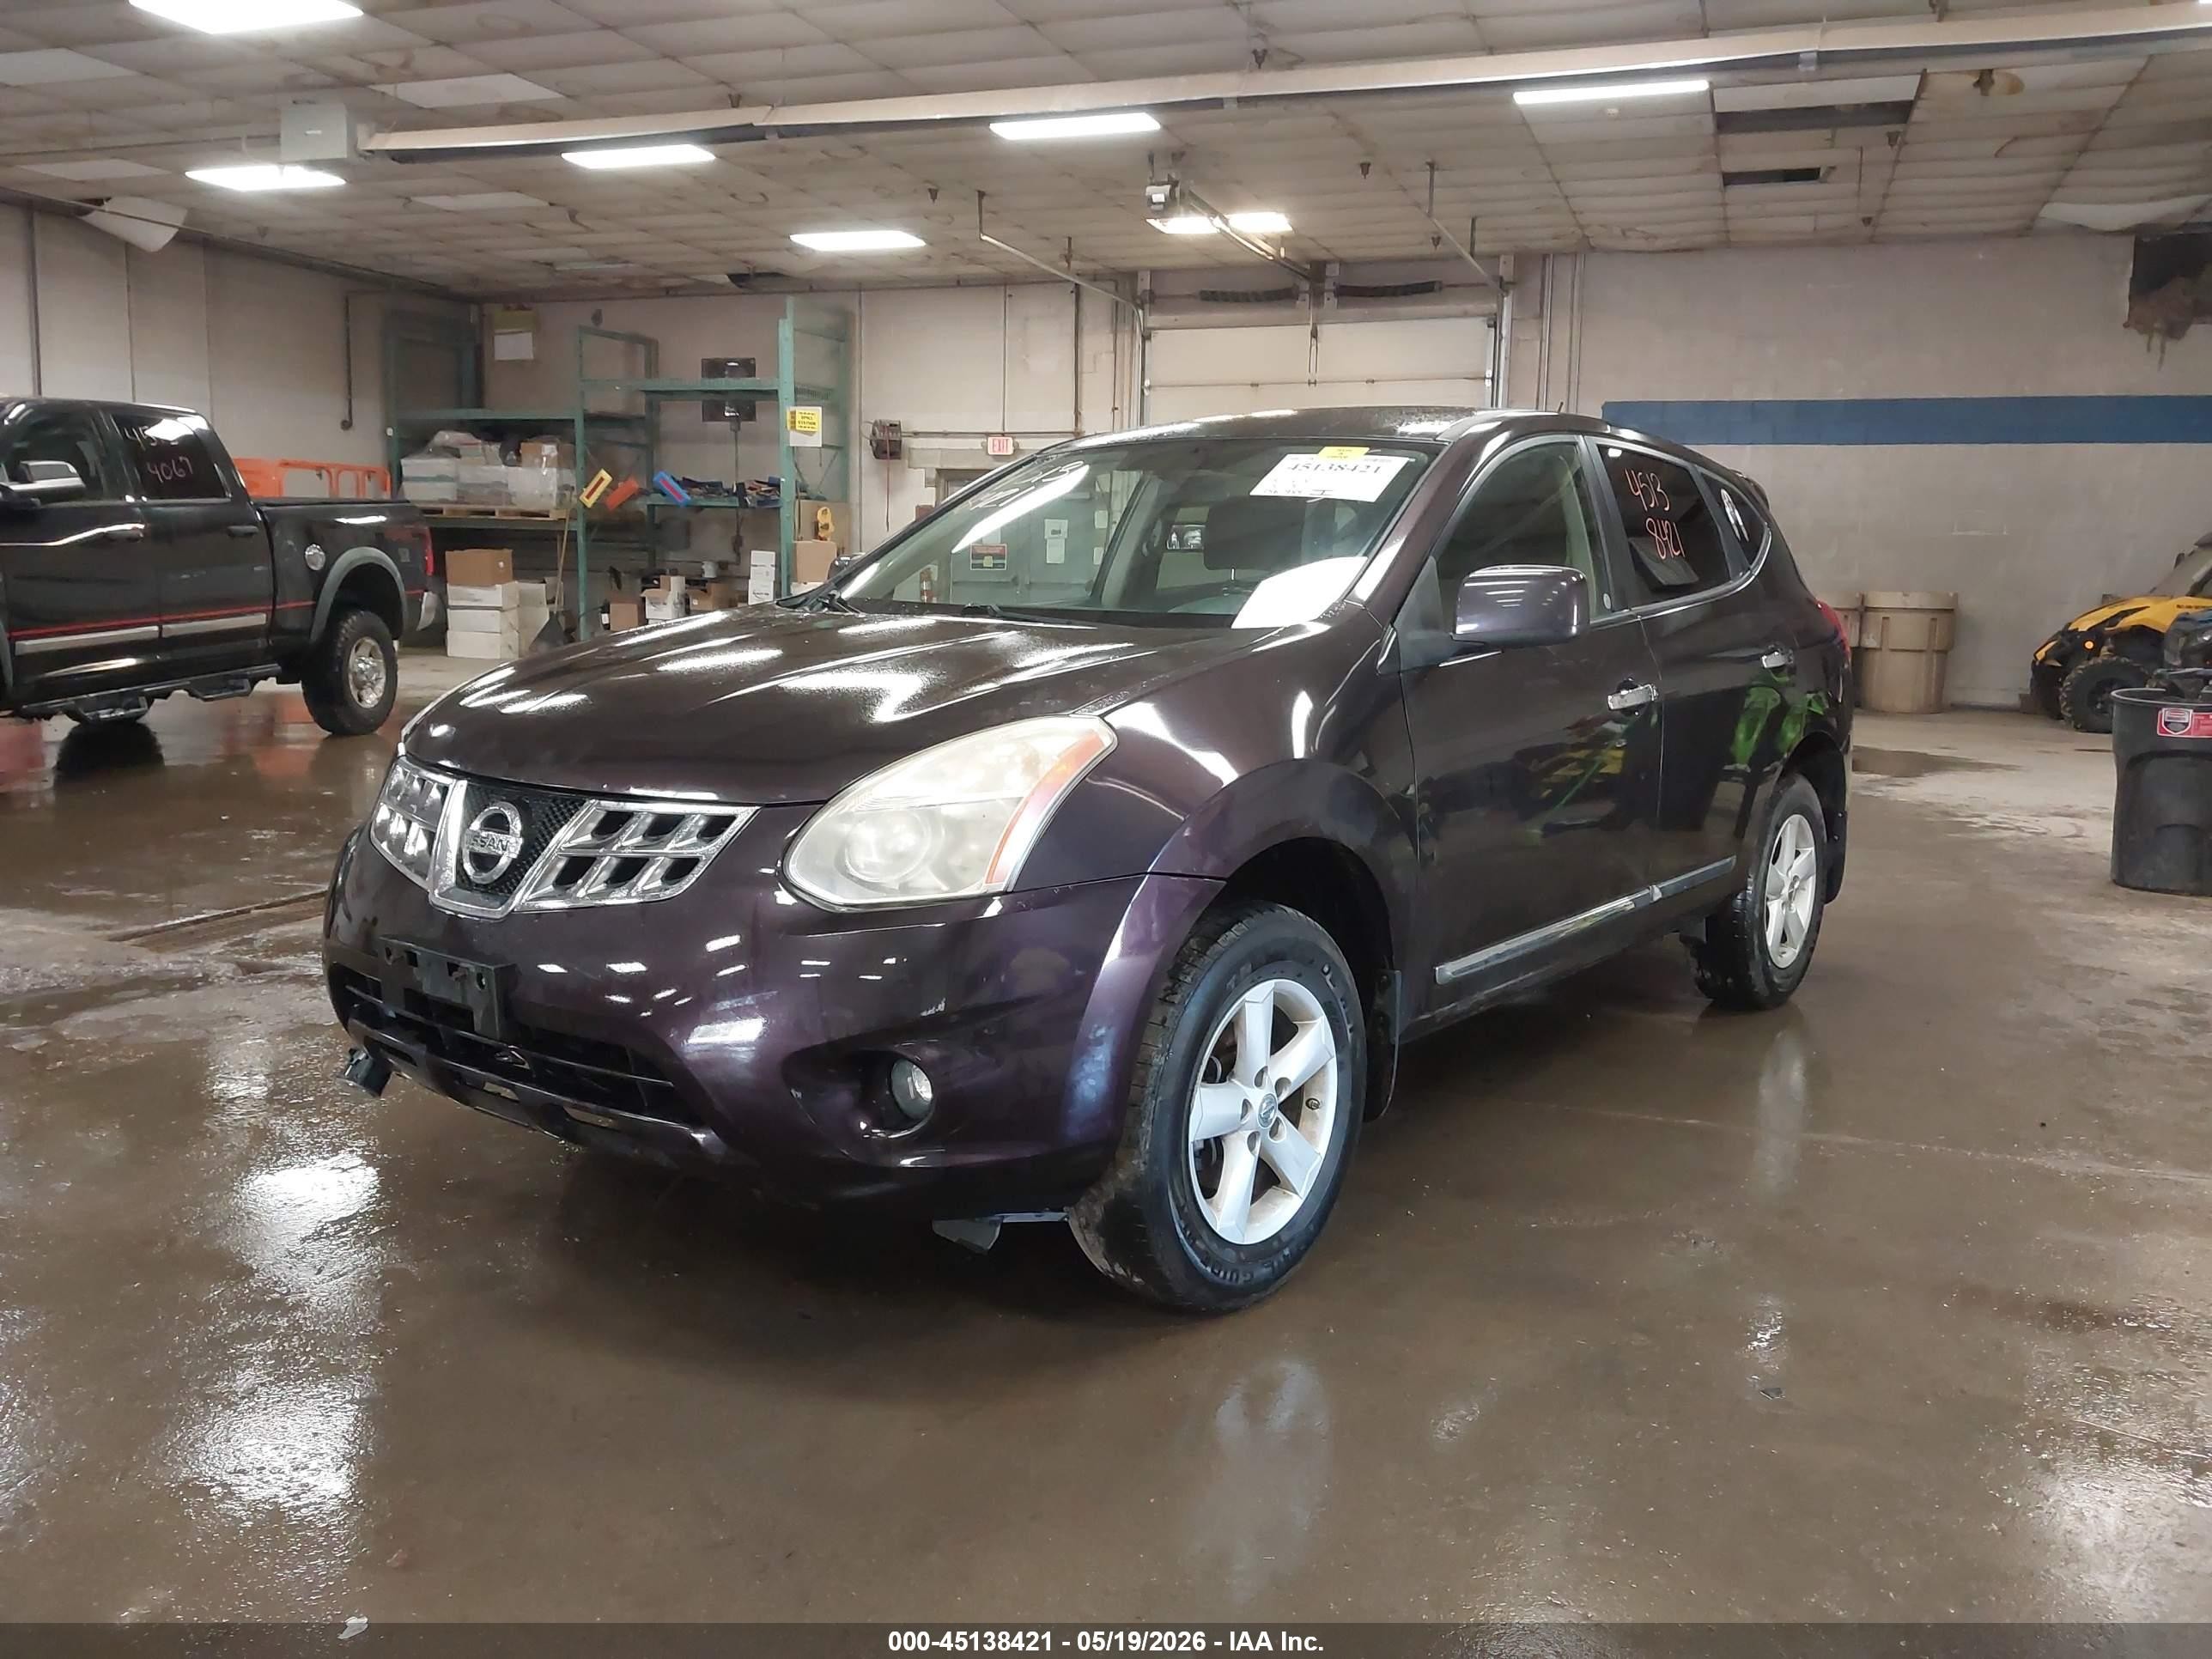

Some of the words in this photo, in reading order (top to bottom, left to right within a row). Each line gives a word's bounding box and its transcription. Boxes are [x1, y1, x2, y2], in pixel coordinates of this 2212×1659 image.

[993, 439, 1008, 453] EXIT
[146, 456, 192, 483] 4067
[1288, 463, 1381, 473] 45138421
[1625, 468, 1669, 511] 4513
[1646, 518, 1685, 560] 8421
